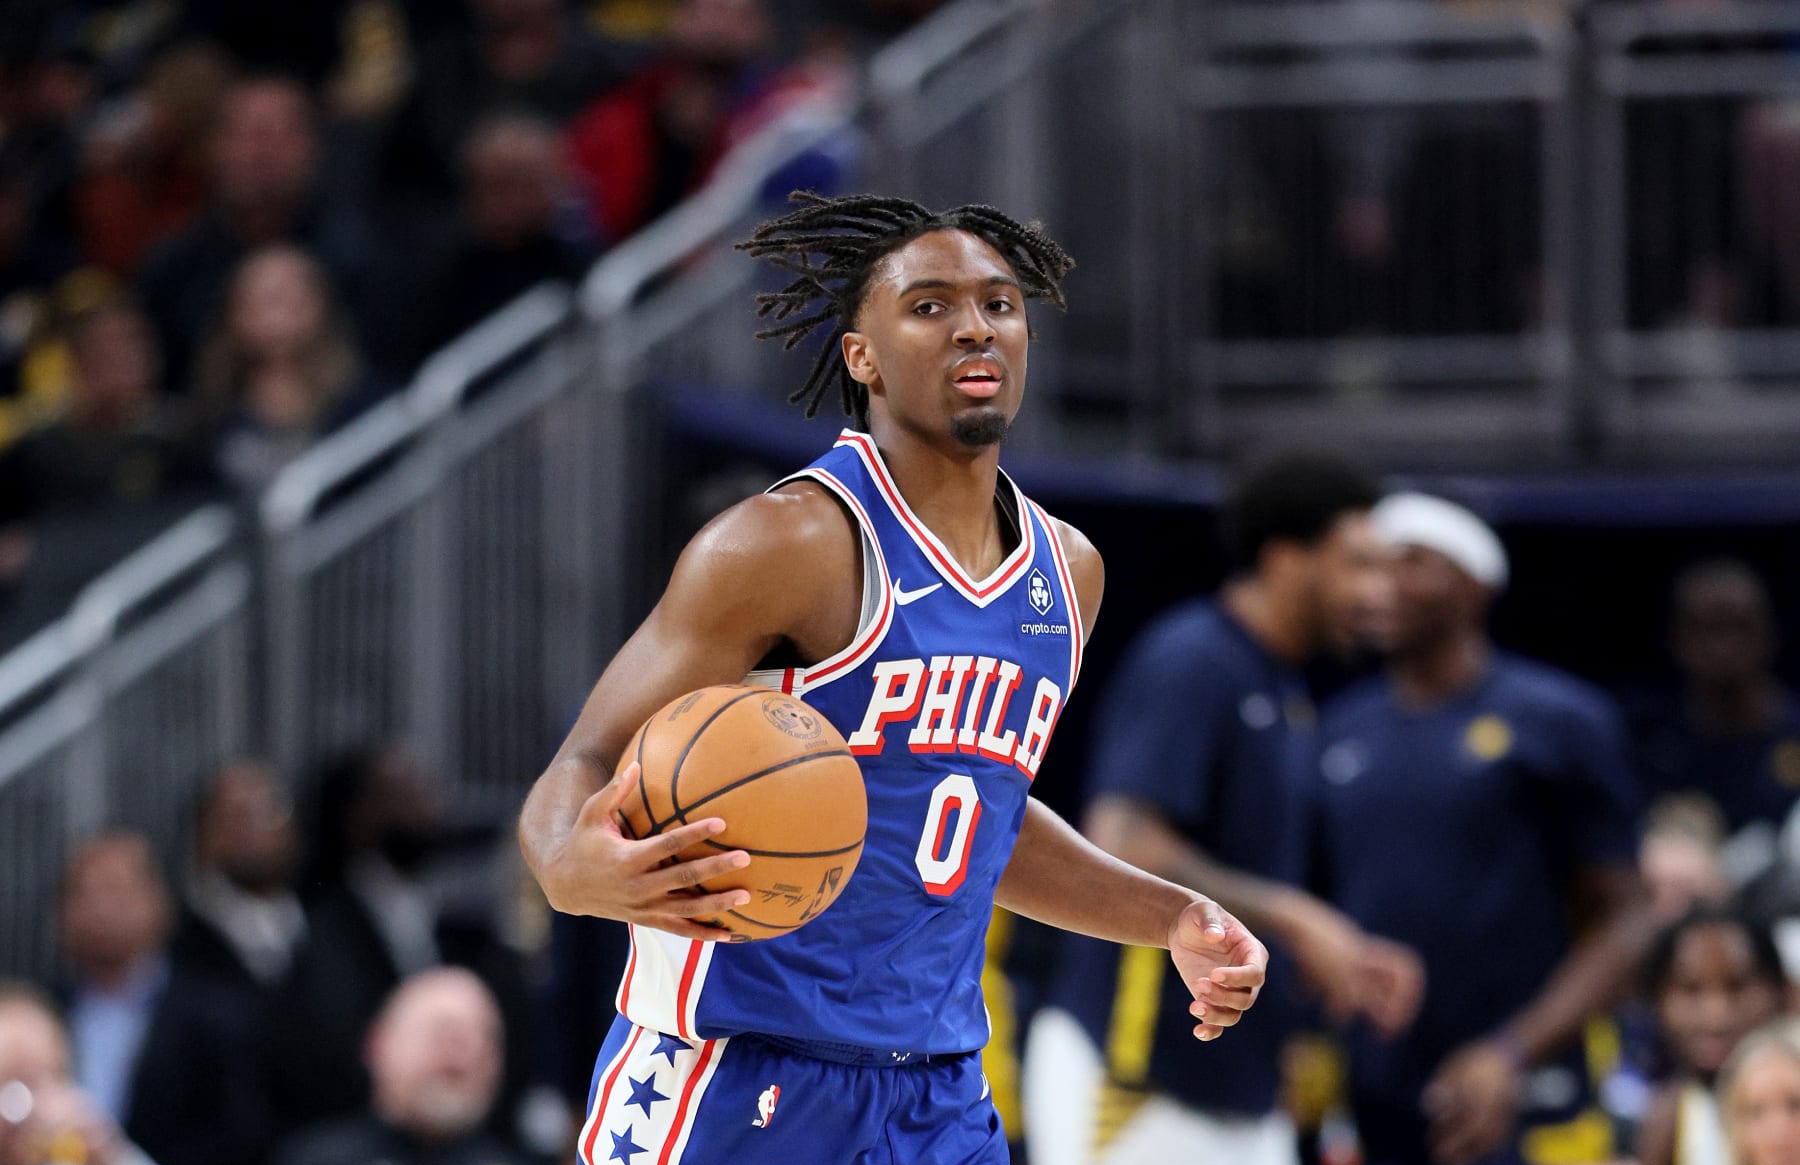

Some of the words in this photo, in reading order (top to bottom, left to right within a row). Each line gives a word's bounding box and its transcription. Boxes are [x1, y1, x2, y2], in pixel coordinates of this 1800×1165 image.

[1021, 622, 1068, 636] crypto.com
[847, 655, 1063, 782] PHILA
[914, 773, 983, 897] 0
